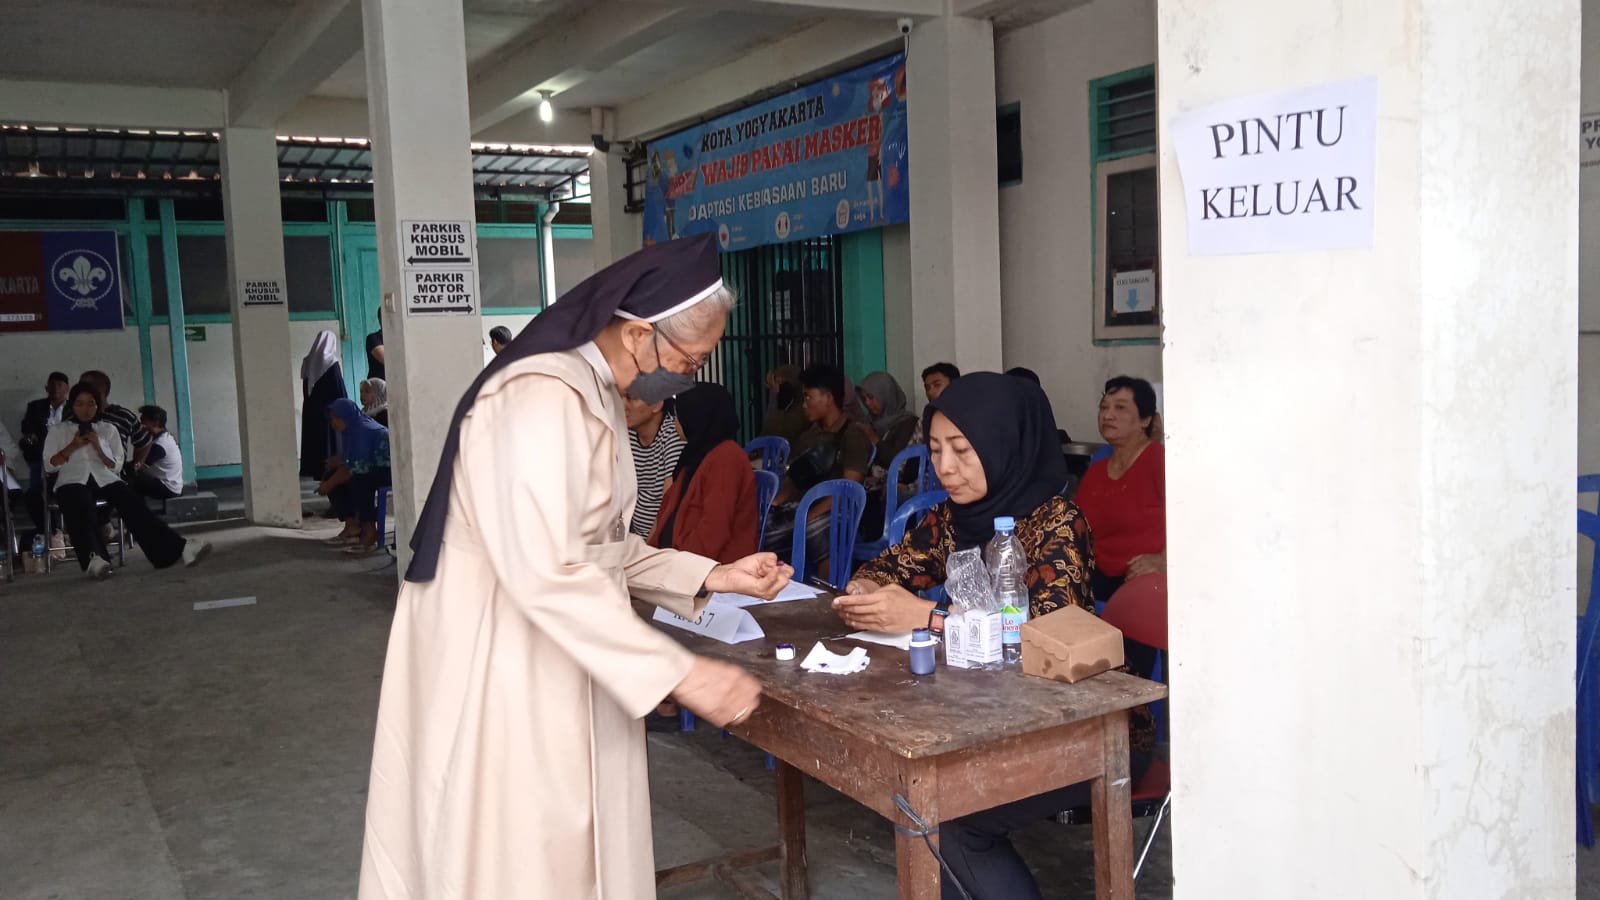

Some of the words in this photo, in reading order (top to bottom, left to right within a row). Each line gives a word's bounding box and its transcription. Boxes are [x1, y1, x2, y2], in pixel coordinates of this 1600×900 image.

[701, 127, 733, 153] KOTA
[736, 95, 825, 143] YOGYAKARTA
[1207, 104, 1348, 160] PINTU
[701, 152, 749, 186] WAJIB
[751, 134, 800, 174] PAKAI
[804, 114, 882, 160] MASKER
[739, 180, 807, 212] KEBIASAAN
[811, 169, 847, 196] BARU
[1200, 175, 1362, 220] KELUAR
[412, 223, 461, 233] PARKIR
[411, 234, 465, 244] KHUSUS
[415, 245, 464, 256] MOBIL
[415, 273, 464, 283] PARKIR
[417, 284, 464, 293] MOTOR
[413, 295, 444, 304] STAF
[447, 294, 471, 303] UPT
[705, 612, 715, 628] 7
